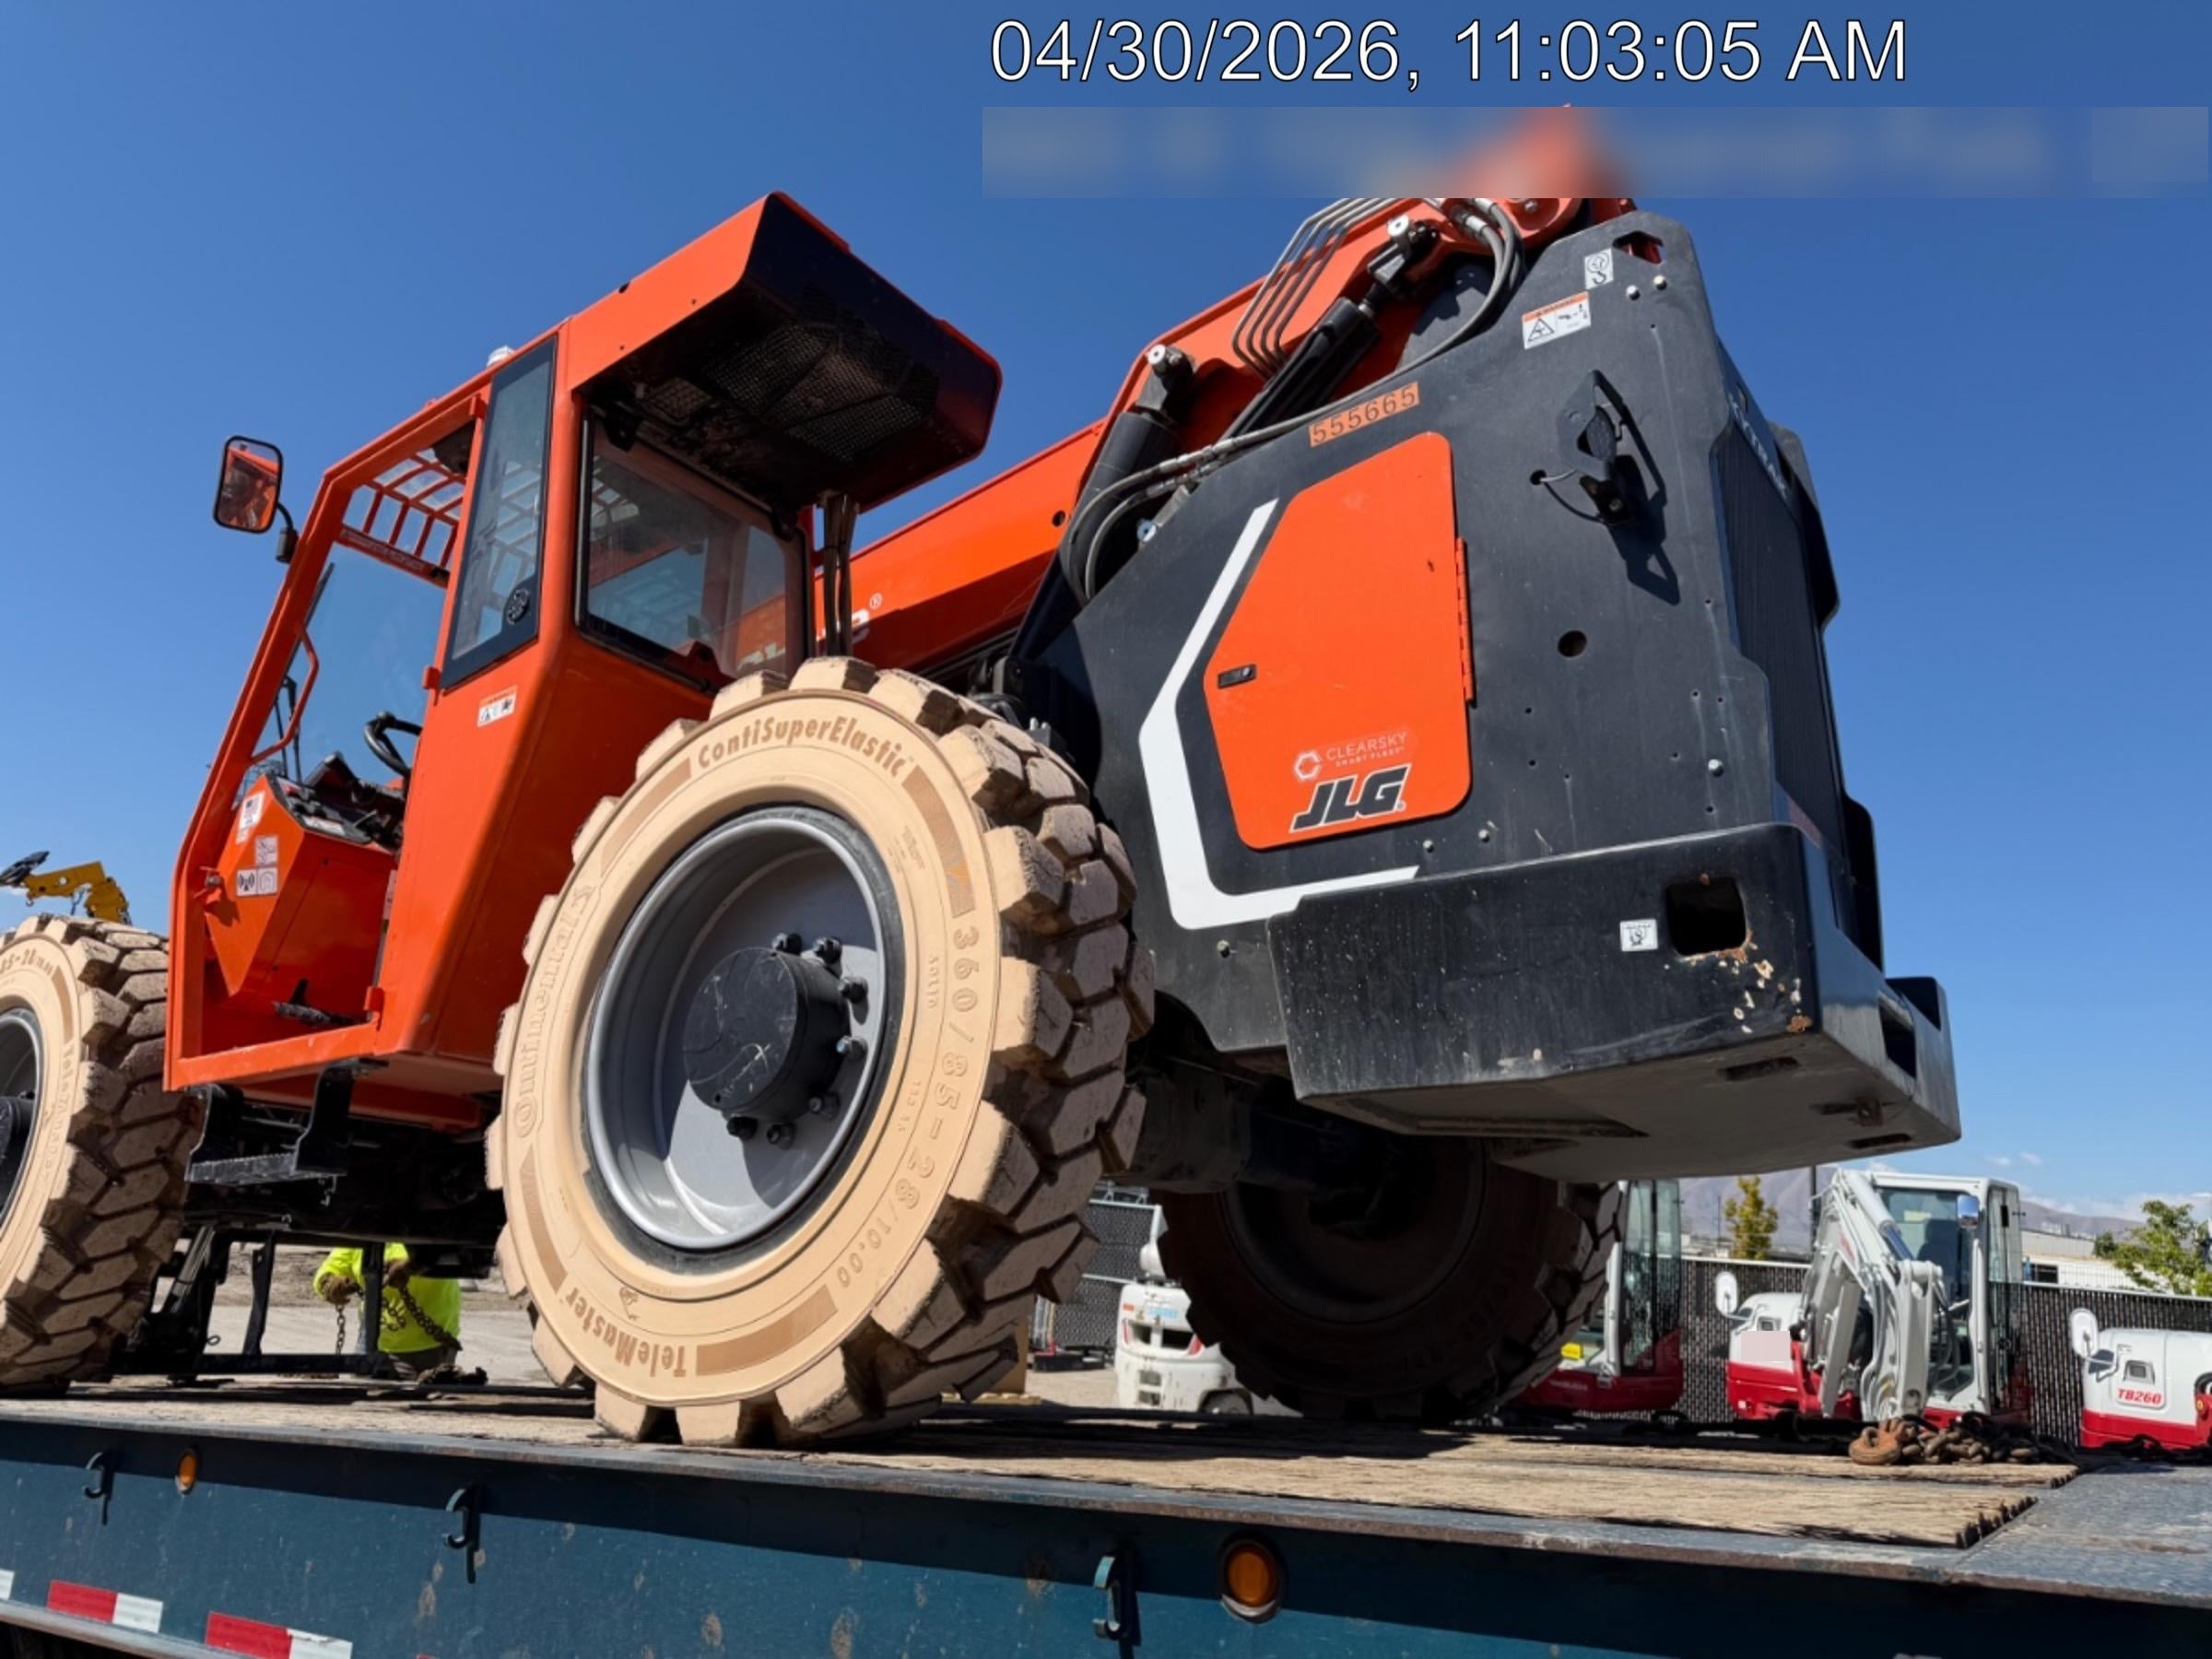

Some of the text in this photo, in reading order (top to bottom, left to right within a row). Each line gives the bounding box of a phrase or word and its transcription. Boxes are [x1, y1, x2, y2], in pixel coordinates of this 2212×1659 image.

[1312, 385, 1416, 441] 555665
[698, 716, 907, 778] ContiSuperElastic
[1326, 732, 1407, 759] CLEARSKY
[1289, 763, 1412, 833] JLG
[565, 1287, 687, 1377] TeleMaster
[2118, 1389, 2162, 1405] TB260
